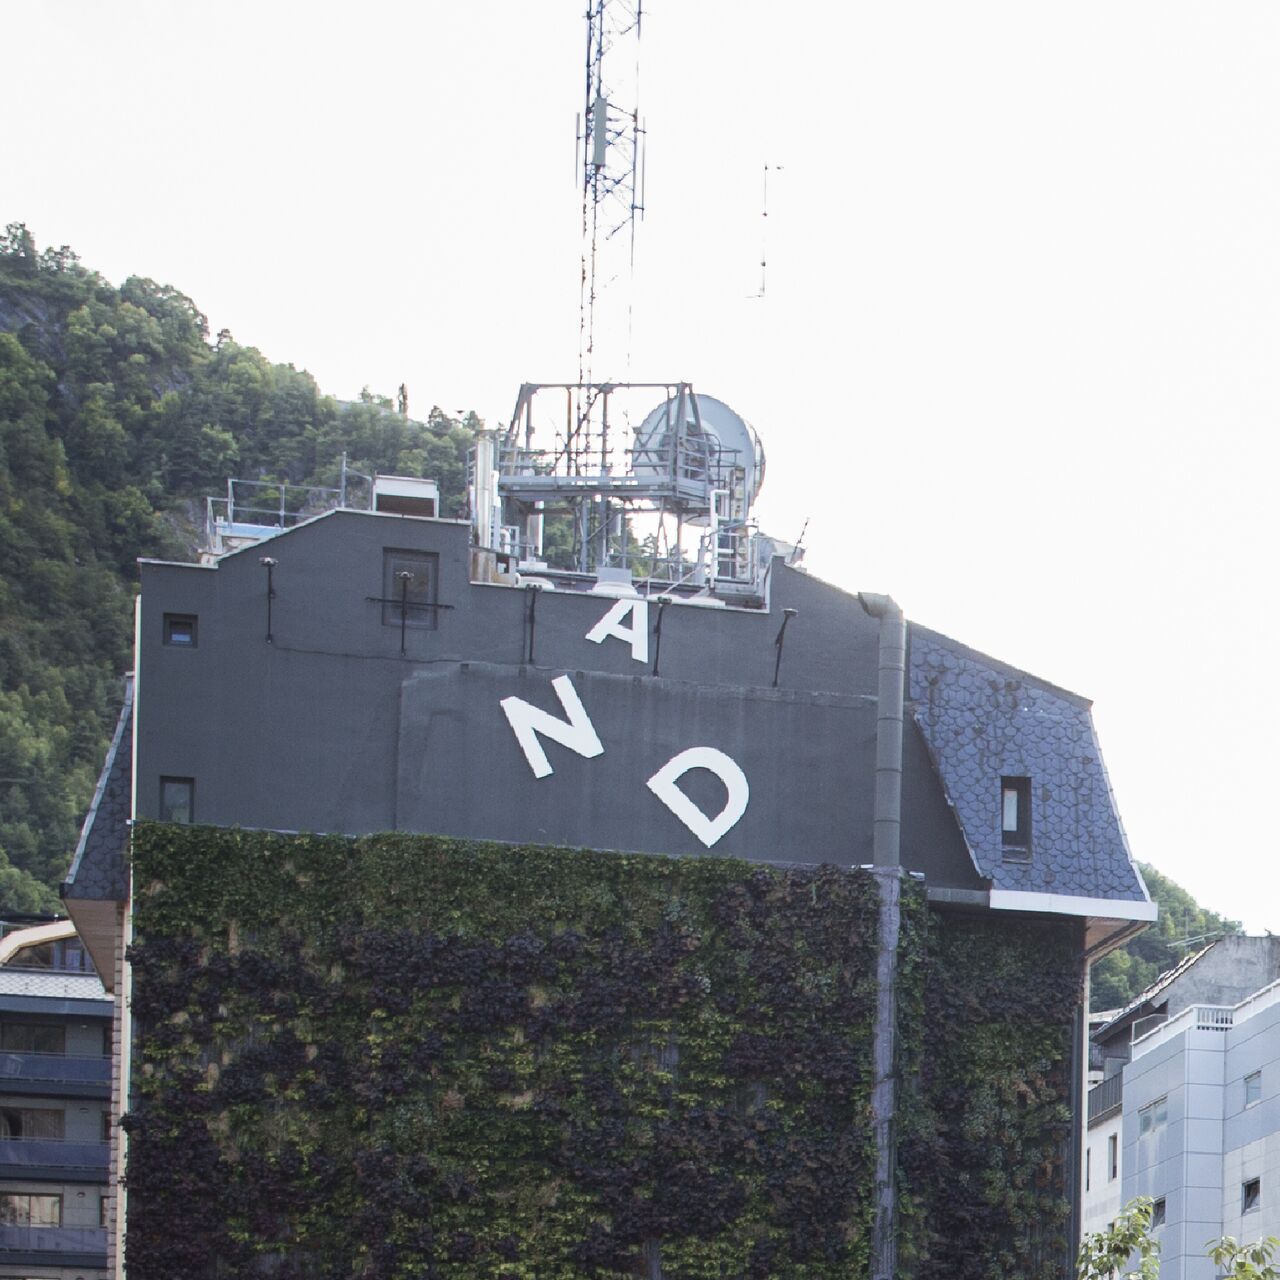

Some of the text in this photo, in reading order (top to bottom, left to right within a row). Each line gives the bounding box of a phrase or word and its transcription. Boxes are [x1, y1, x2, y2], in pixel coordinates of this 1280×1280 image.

[585, 594, 650, 664] A
[499, 675, 604, 779] N
[647, 746, 751, 848] D
